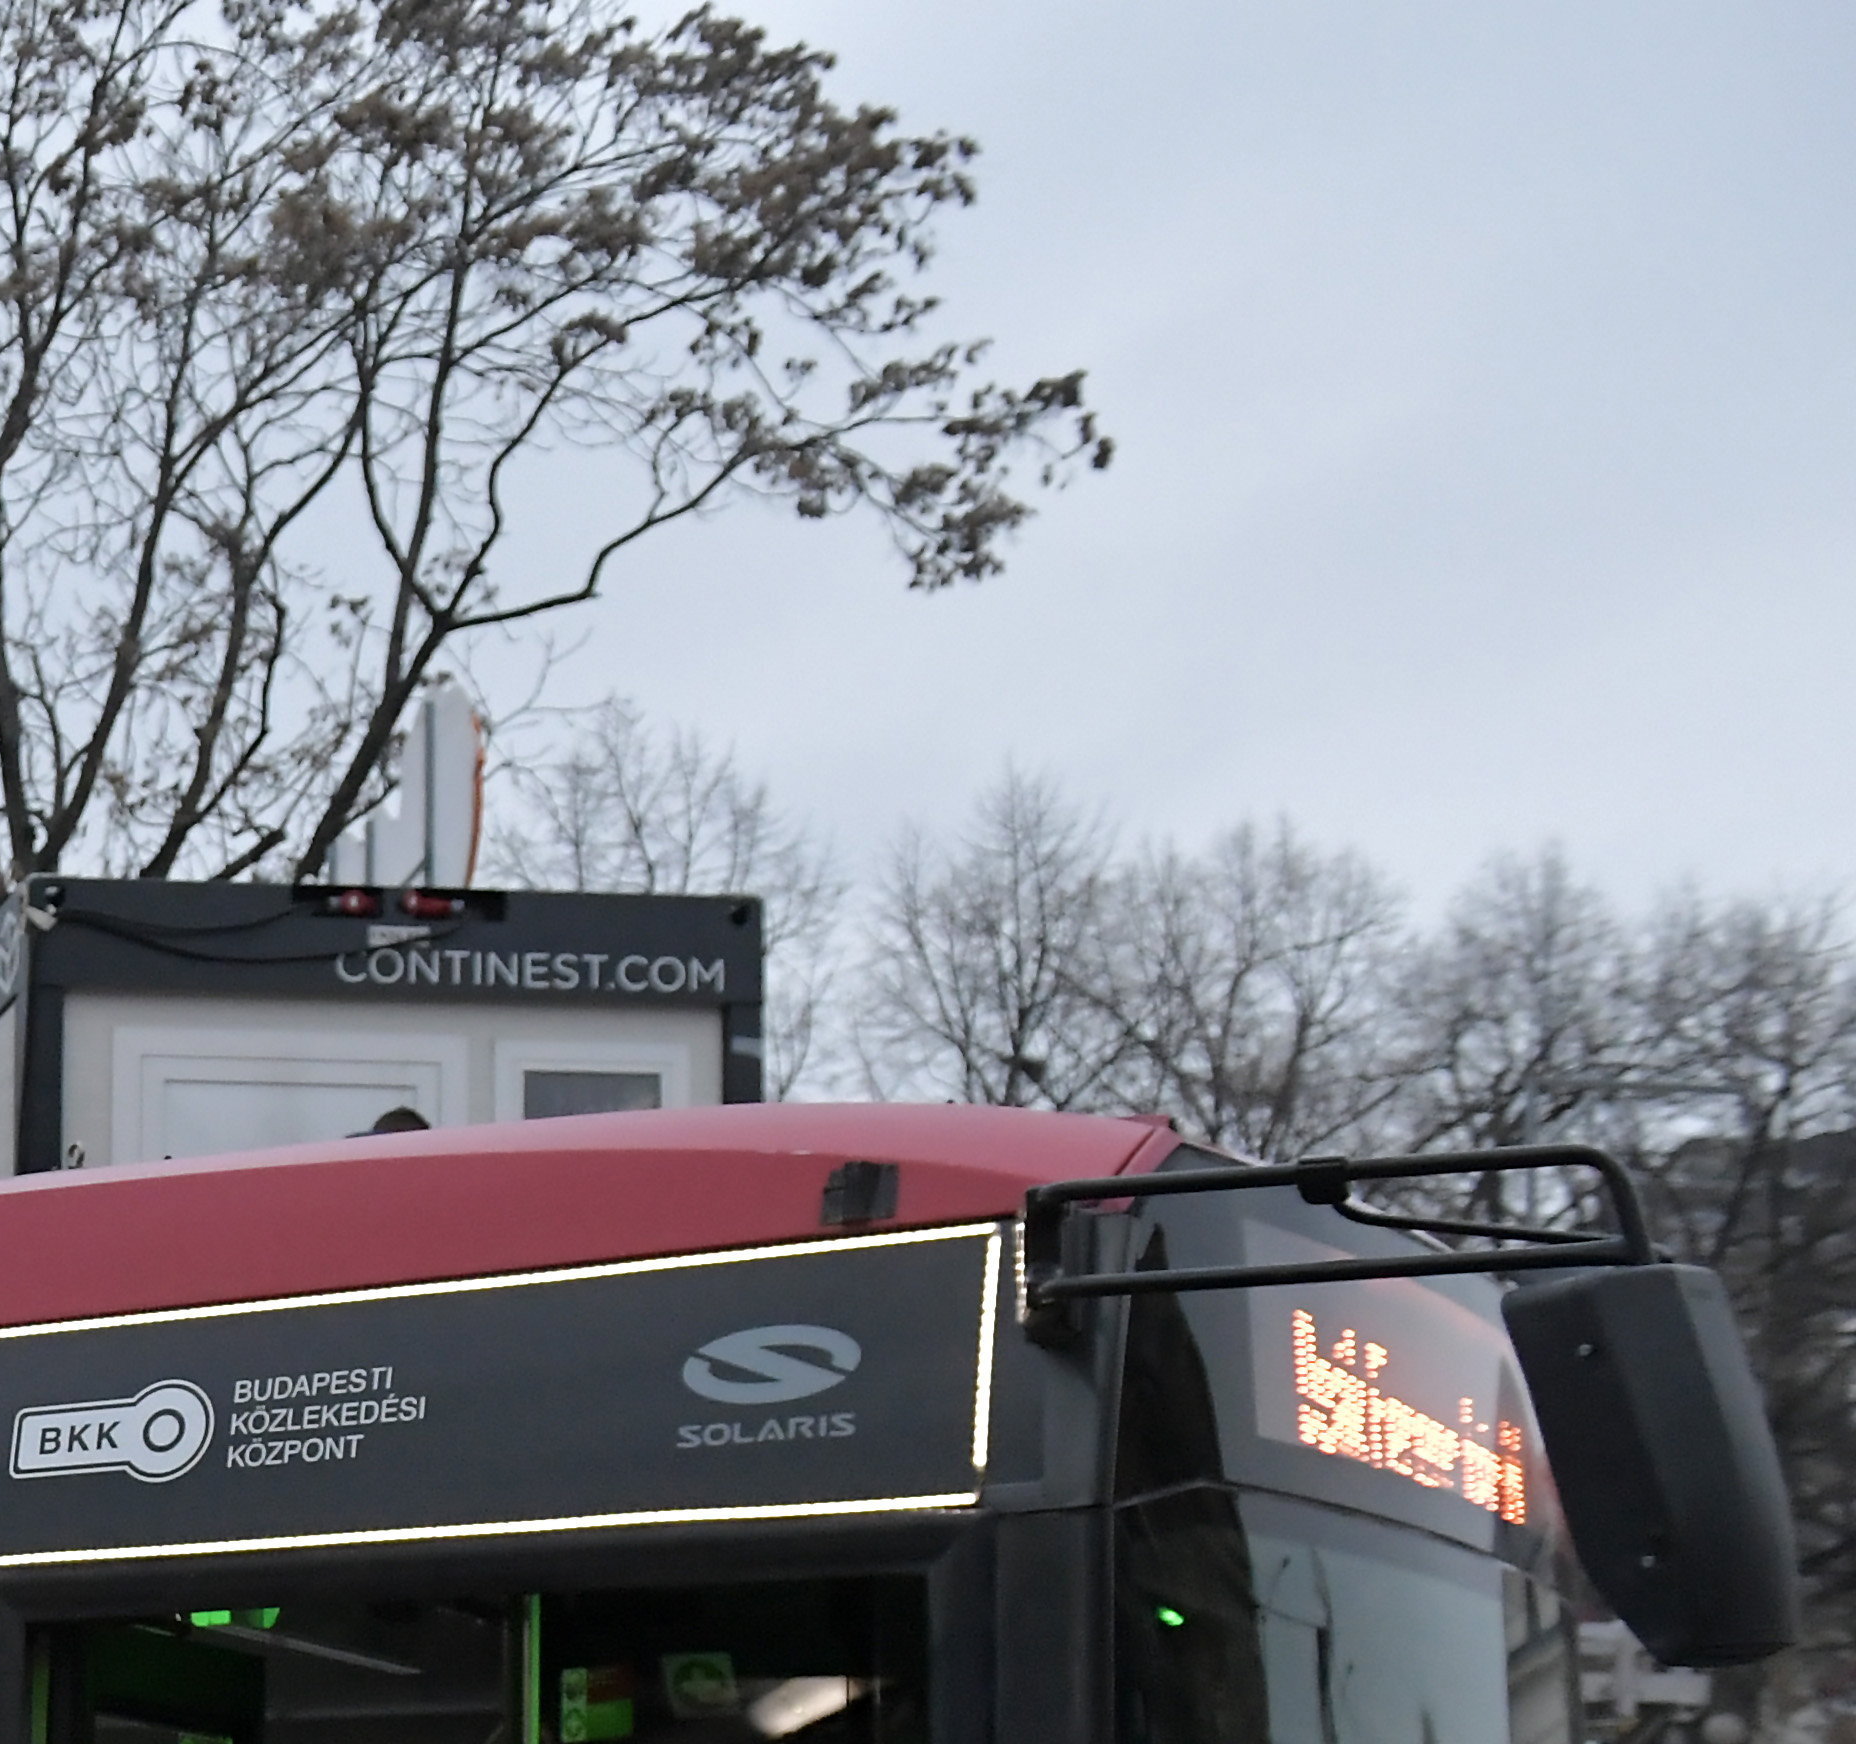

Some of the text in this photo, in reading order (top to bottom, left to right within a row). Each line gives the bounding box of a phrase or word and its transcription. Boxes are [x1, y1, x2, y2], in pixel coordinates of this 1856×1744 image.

[335, 949, 725, 993] CONTINEST.COM
[233, 1366, 393, 1404] BUDAPESTI
[229, 1393, 426, 1436] KÖZLEKEDÉSI
[676, 1411, 857, 1449] SOLARIS
[39, 1420, 121, 1455] BKK
[226, 1434, 365, 1468] KÖZPONT
